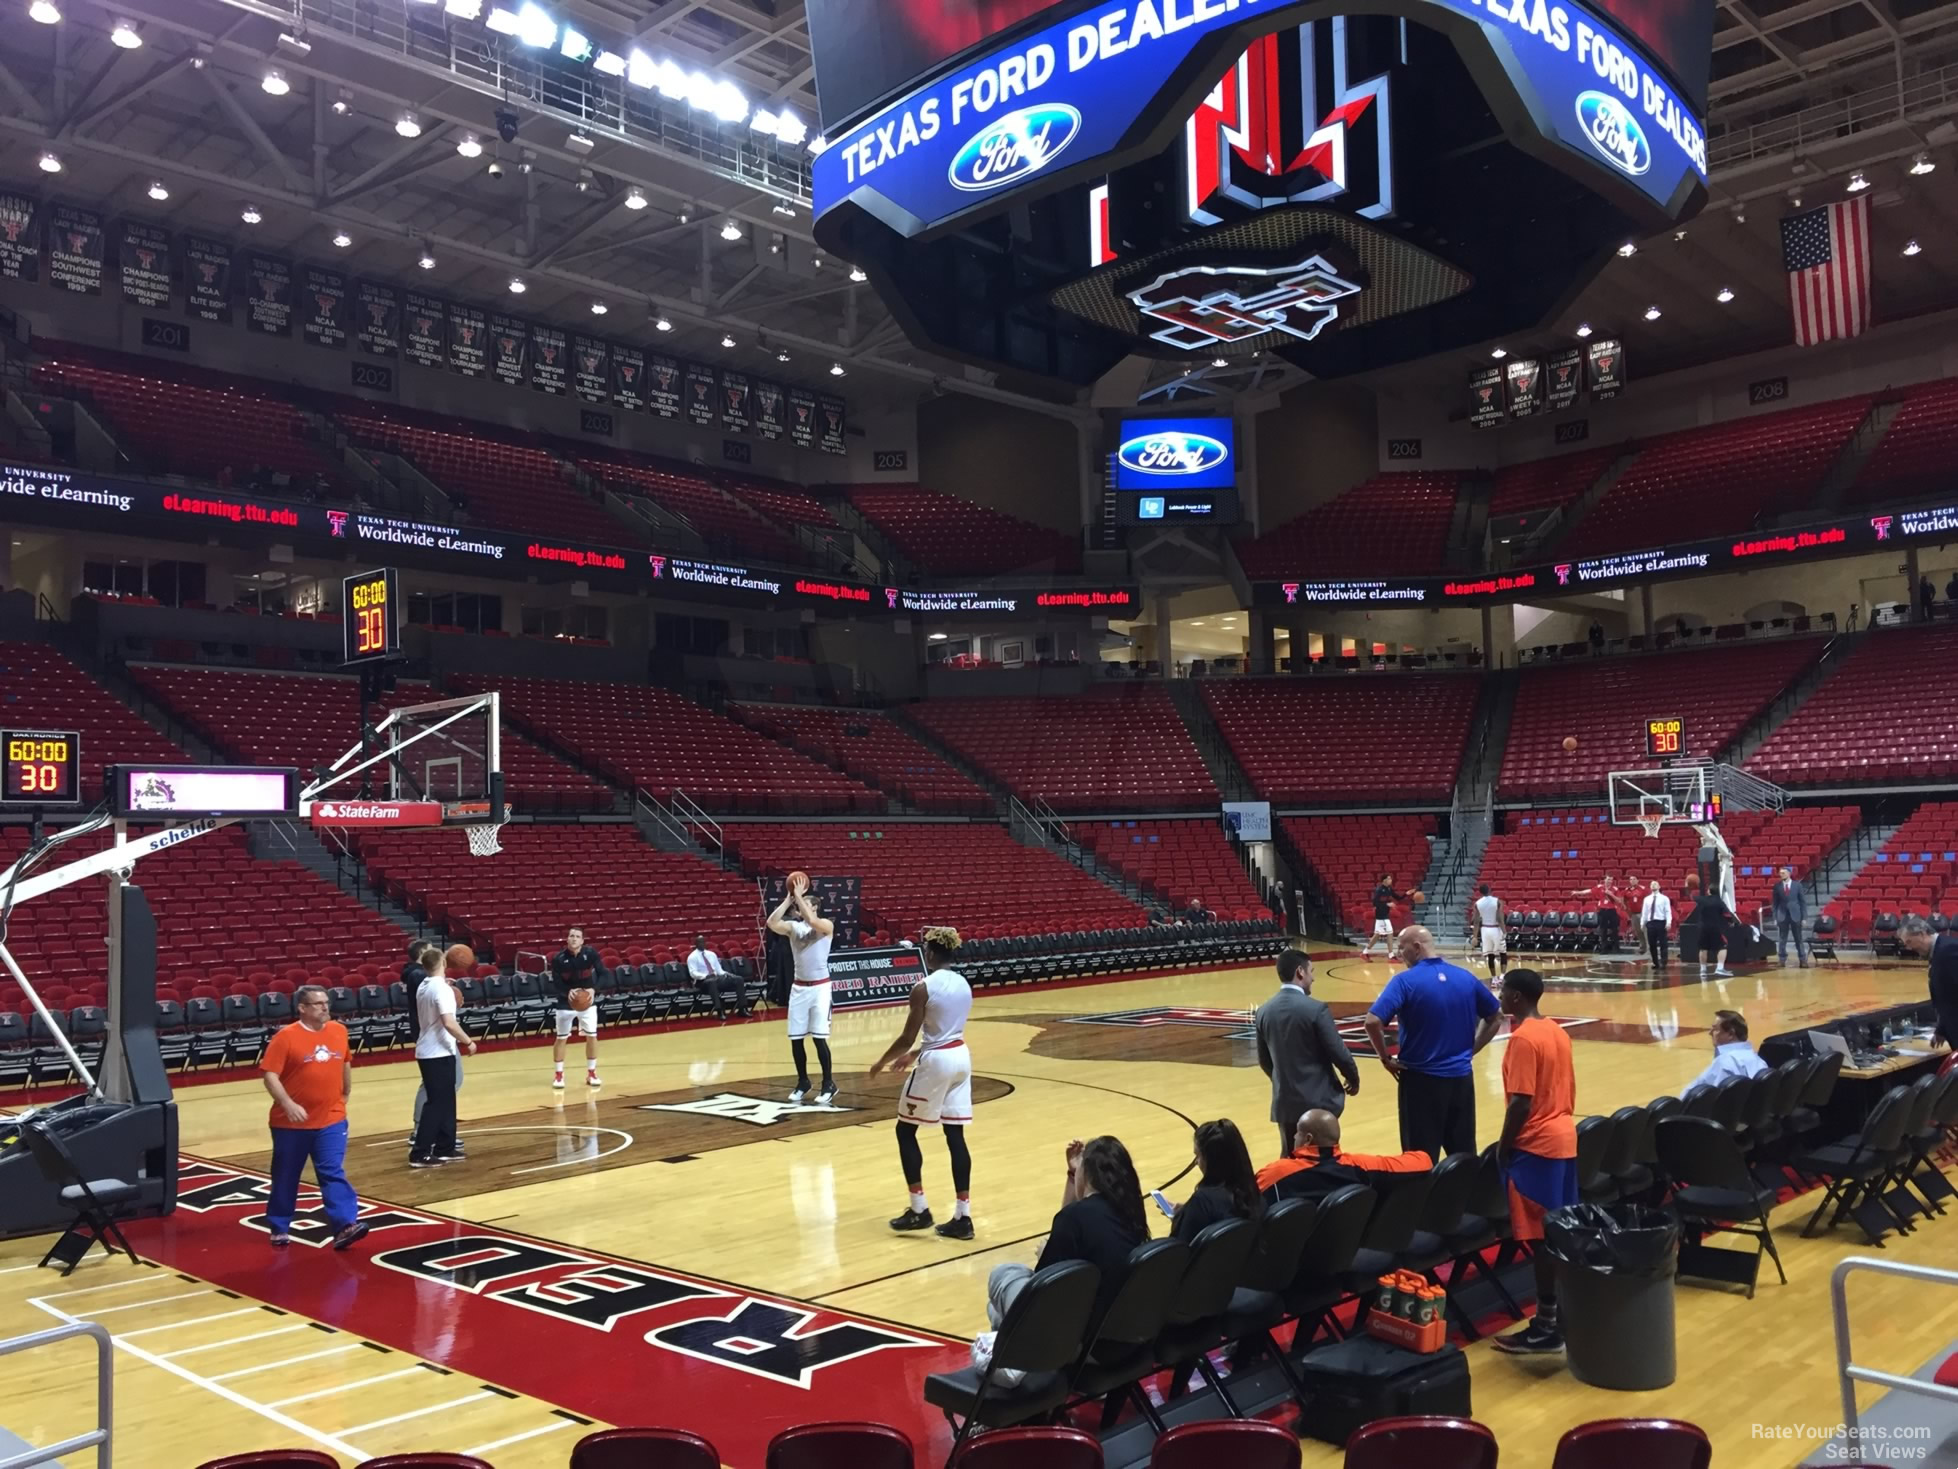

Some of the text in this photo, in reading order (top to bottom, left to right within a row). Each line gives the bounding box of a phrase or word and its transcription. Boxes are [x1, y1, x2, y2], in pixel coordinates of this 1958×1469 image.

[1576, 21, 1638, 99] FORD
[1642, 73, 1707, 176] DEALERS
[842, 98, 941, 183] TEXAS
[952, 44, 1055, 125] FORD
[1593, 102, 1638, 170] Ford
[972, 121, 1052, 182] Ford
[52, 251, 101, 268] CHAMPIONS
[52, 261, 101, 277] SOUTHWEST
[123, 267, 169, 282] CHAMPIONS
[51, 271, 100, 287] CONFERENCE
[197, 285, 220, 296] NCAA
[315, 316, 336, 327] NCAA
[152, 325, 181, 345] 201
[368, 326, 388, 336] NCAA
[357, 367, 387, 387] 202
[1556, 382, 1572, 390] NCAA
[1514, 394, 1533, 403] NCAA
[1754, 382, 1784, 400] 208
[584, 414, 609, 432] 203
[1560, 426, 1584, 440] 207
[1138, 439, 1205, 468] Ford
[1392, 442, 1417, 456] 206
[878, 454, 904, 468] 205
[5, 467, 72, 482] UNIVERSITY
[41, 484, 130, 511] eLearning
[163, 493, 298, 526] eLearning.ttu.edu
[1901, 507, 1955, 521] TEXAS TECH
[358, 516, 460, 536] TEXAS TECH UNIVERSITY
[358, 524, 504, 559] Worldwide eLearning
[1732, 528, 1846, 557] eLearning.ttu.edu
[528, 544, 626, 570] eLearning.ttu.edu
[1578, 560, 1599, 569] TEXAS
[1622, 551, 1665, 562] UNIVERSITY
[1579, 553, 1708, 581] Worldwide eLearning
[672, 567, 780, 594] Worldwide eLearning
[1444, 573, 1535, 596] eLearning.ttu.edu
[353, 580, 385, 609] 60:00
[796, 580, 870, 601] eLearning.ttu.edu
[1037, 591, 1129, 607] eLearning.ttu.edu
[1306, 588, 1424, 601] Worldwide eLearning
[902, 597, 1016, 611] Worldwide eLearning
[359, 608, 382, 651] 30
[1650, 722, 1680, 734] 60:00
[10, 741, 67, 762] 60:00
[1656, 733, 1678, 752] 30
[21, 765, 56, 790] 30
[150, 818, 217, 850] schelde
[828, 961, 858, 973] PROTECT
[857, 960, 870, 970] THIS
[832, 976, 864, 991] RED
[848, 982, 914, 998] BASKETBAL
[1380, 1294, 1391, 1308] G
[371, 1233, 944, 1391] RED
[1421, 1308, 1432, 1321] G
